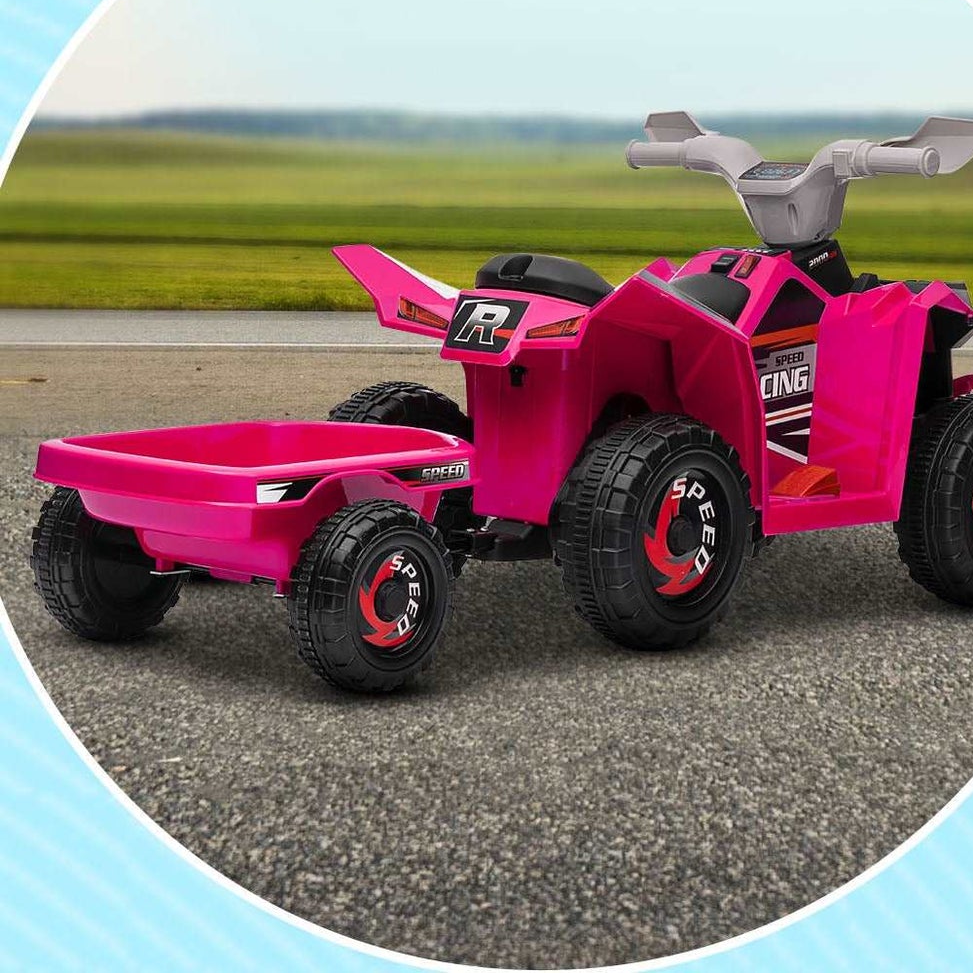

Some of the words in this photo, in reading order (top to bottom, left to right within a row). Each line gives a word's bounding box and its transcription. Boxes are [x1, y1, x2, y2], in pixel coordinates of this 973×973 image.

[454, 303, 511, 345] R
[775, 351, 804, 367] SPEED
[760, 365, 810, 400] CING
[421, 464, 465, 481] SPEED
[671, 478, 716, 574] SPEED
[390, 555, 421, 636] SPEED
